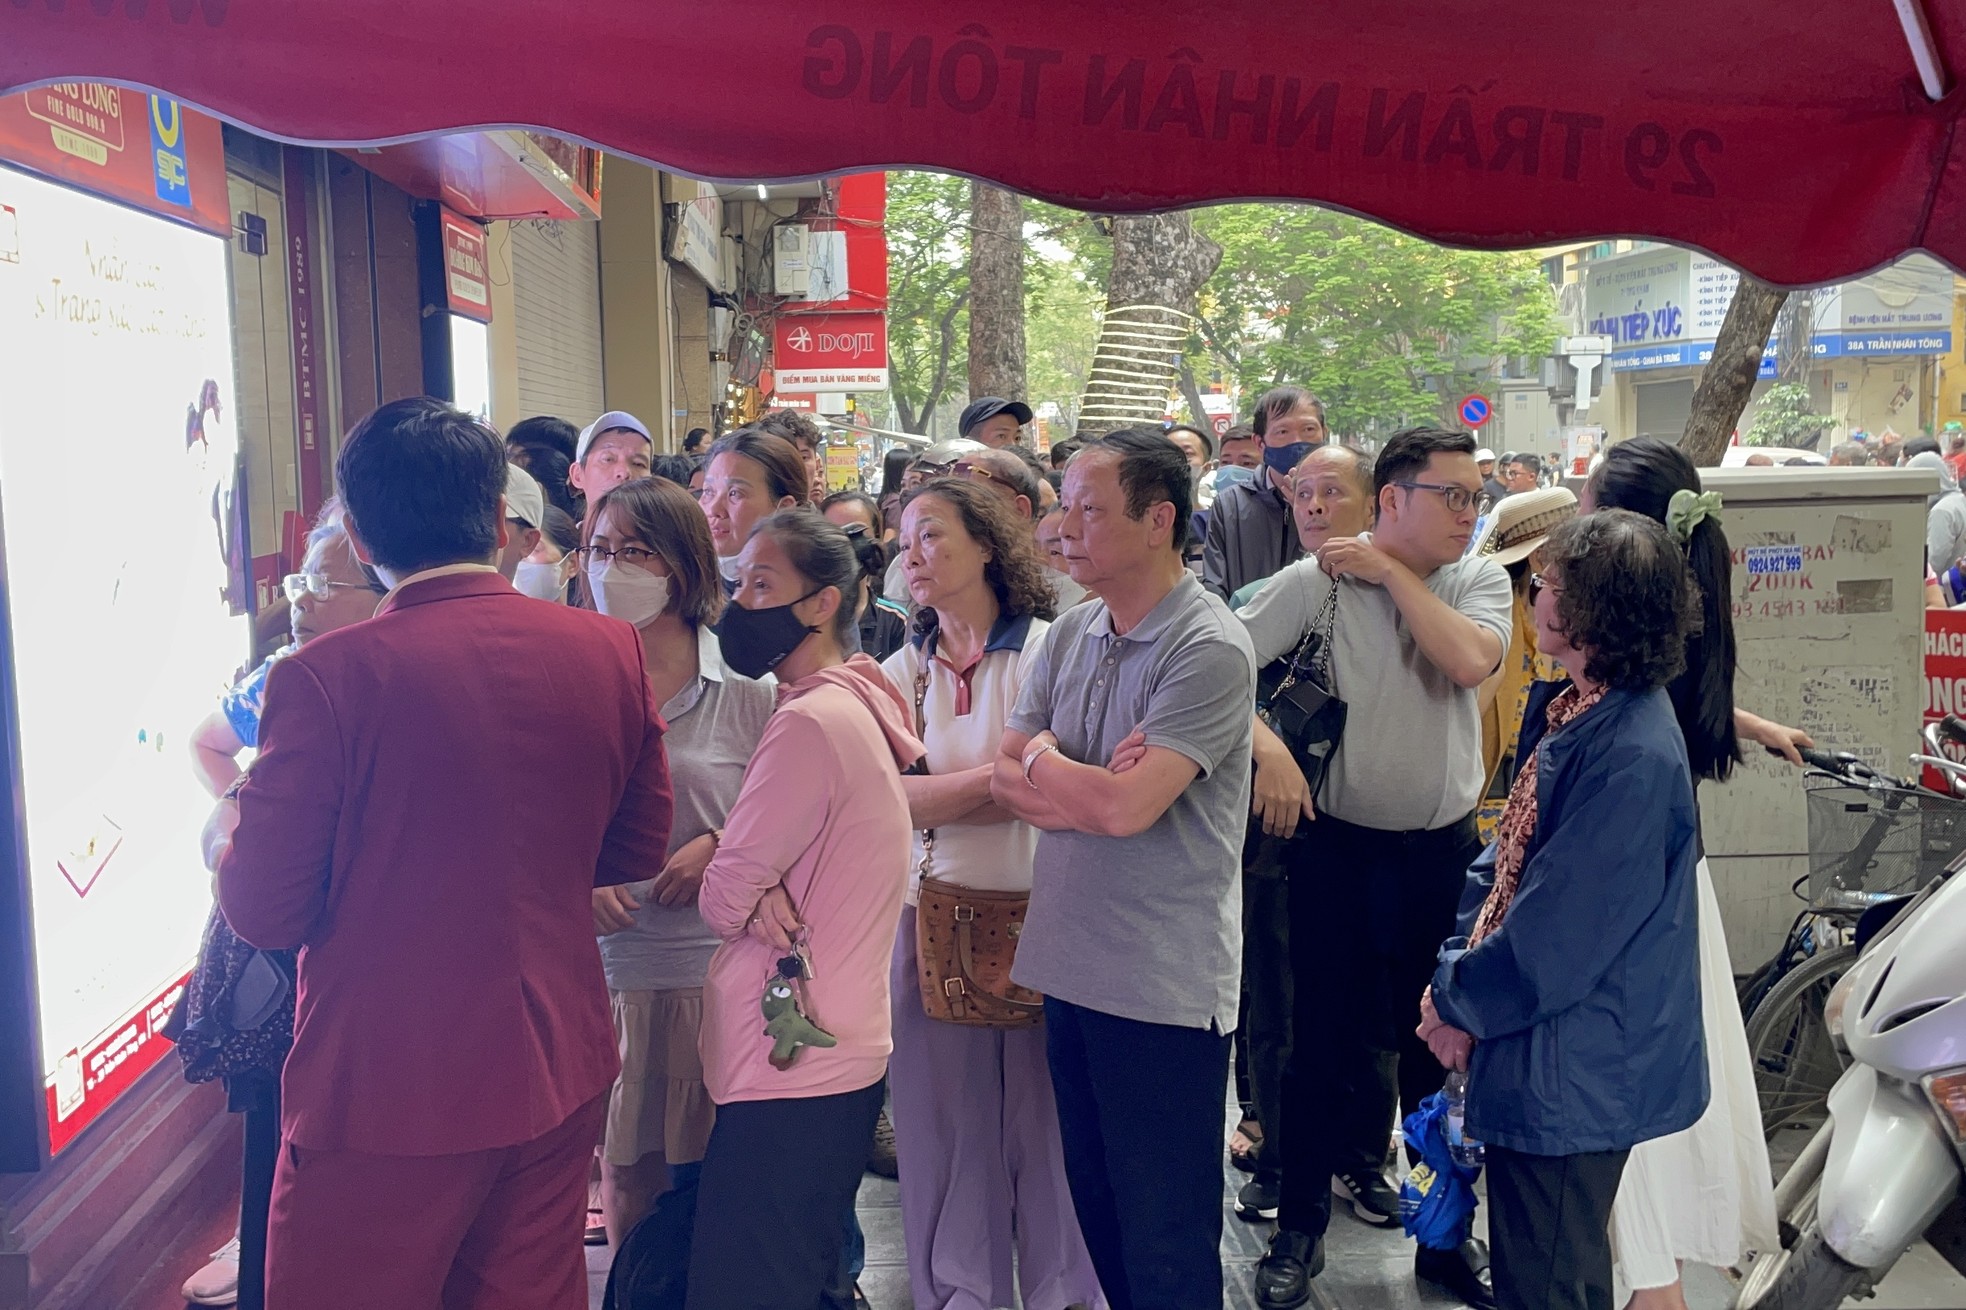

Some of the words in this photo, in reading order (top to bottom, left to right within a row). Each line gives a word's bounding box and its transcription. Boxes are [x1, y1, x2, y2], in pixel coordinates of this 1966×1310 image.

[47, 95, 64, 117] FINE
[66, 103, 84, 125] GOLD
[82, 83, 119, 118] LONG
[1621, 299, 1650, 341] TIẾP
[1653, 300, 1682, 339] XÚC
[299, 307, 311, 398] BTMC
[818, 333, 875, 359] DOJI
[1848, 341, 1864, 350] 38A
[1918, 338, 1943, 348] TÔNG
[803, 376, 818, 384] MUA
